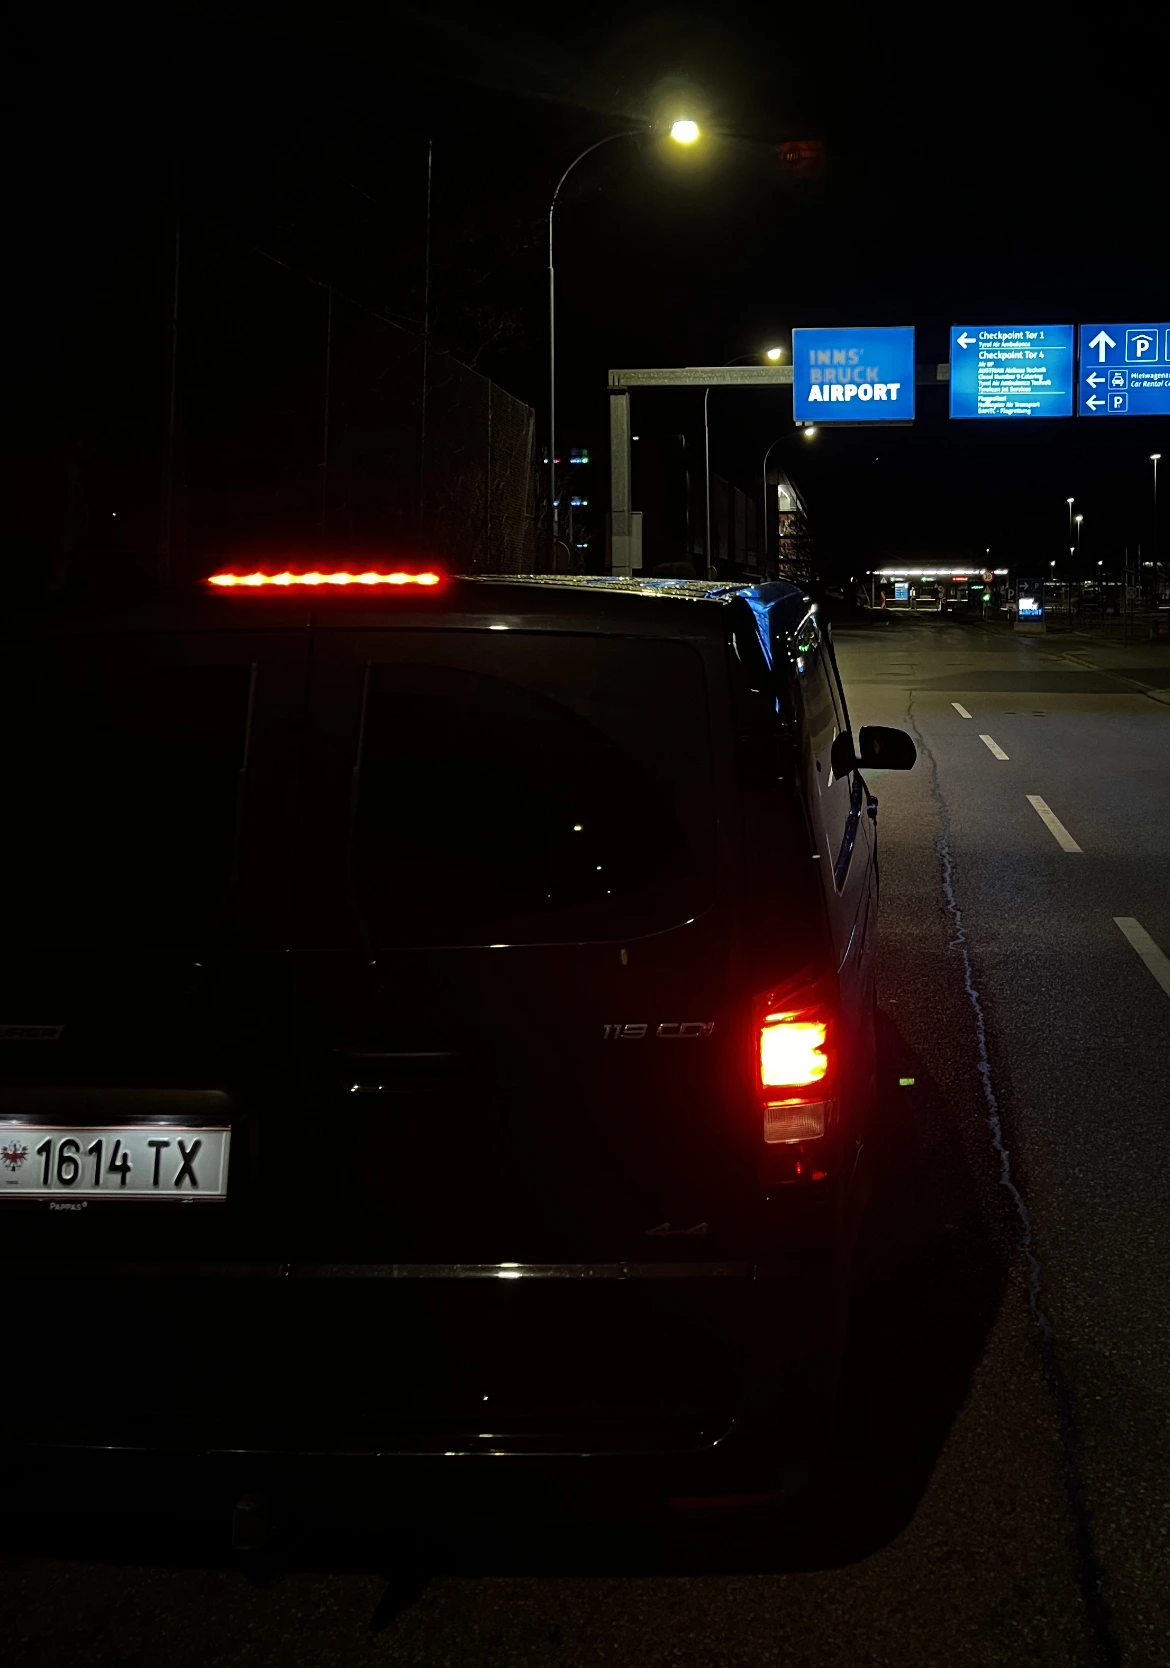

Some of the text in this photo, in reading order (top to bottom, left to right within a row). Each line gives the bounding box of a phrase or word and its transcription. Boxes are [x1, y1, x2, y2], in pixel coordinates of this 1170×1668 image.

[979, 331, 1045, 341] Checkpoint Tor 1
[809, 348, 864, 366] INNS'
[979, 350, 1045, 361] Checkpoint Tor 4
[810, 366, 879, 384] BRUCK
[1130, 372, 1170, 381] Mietwagenz
[807, 384, 900, 403] AIRPORT
[603, 1021, 715, 1040] 119 CDI
[36, 1137, 203, 1188] 1614 TX
